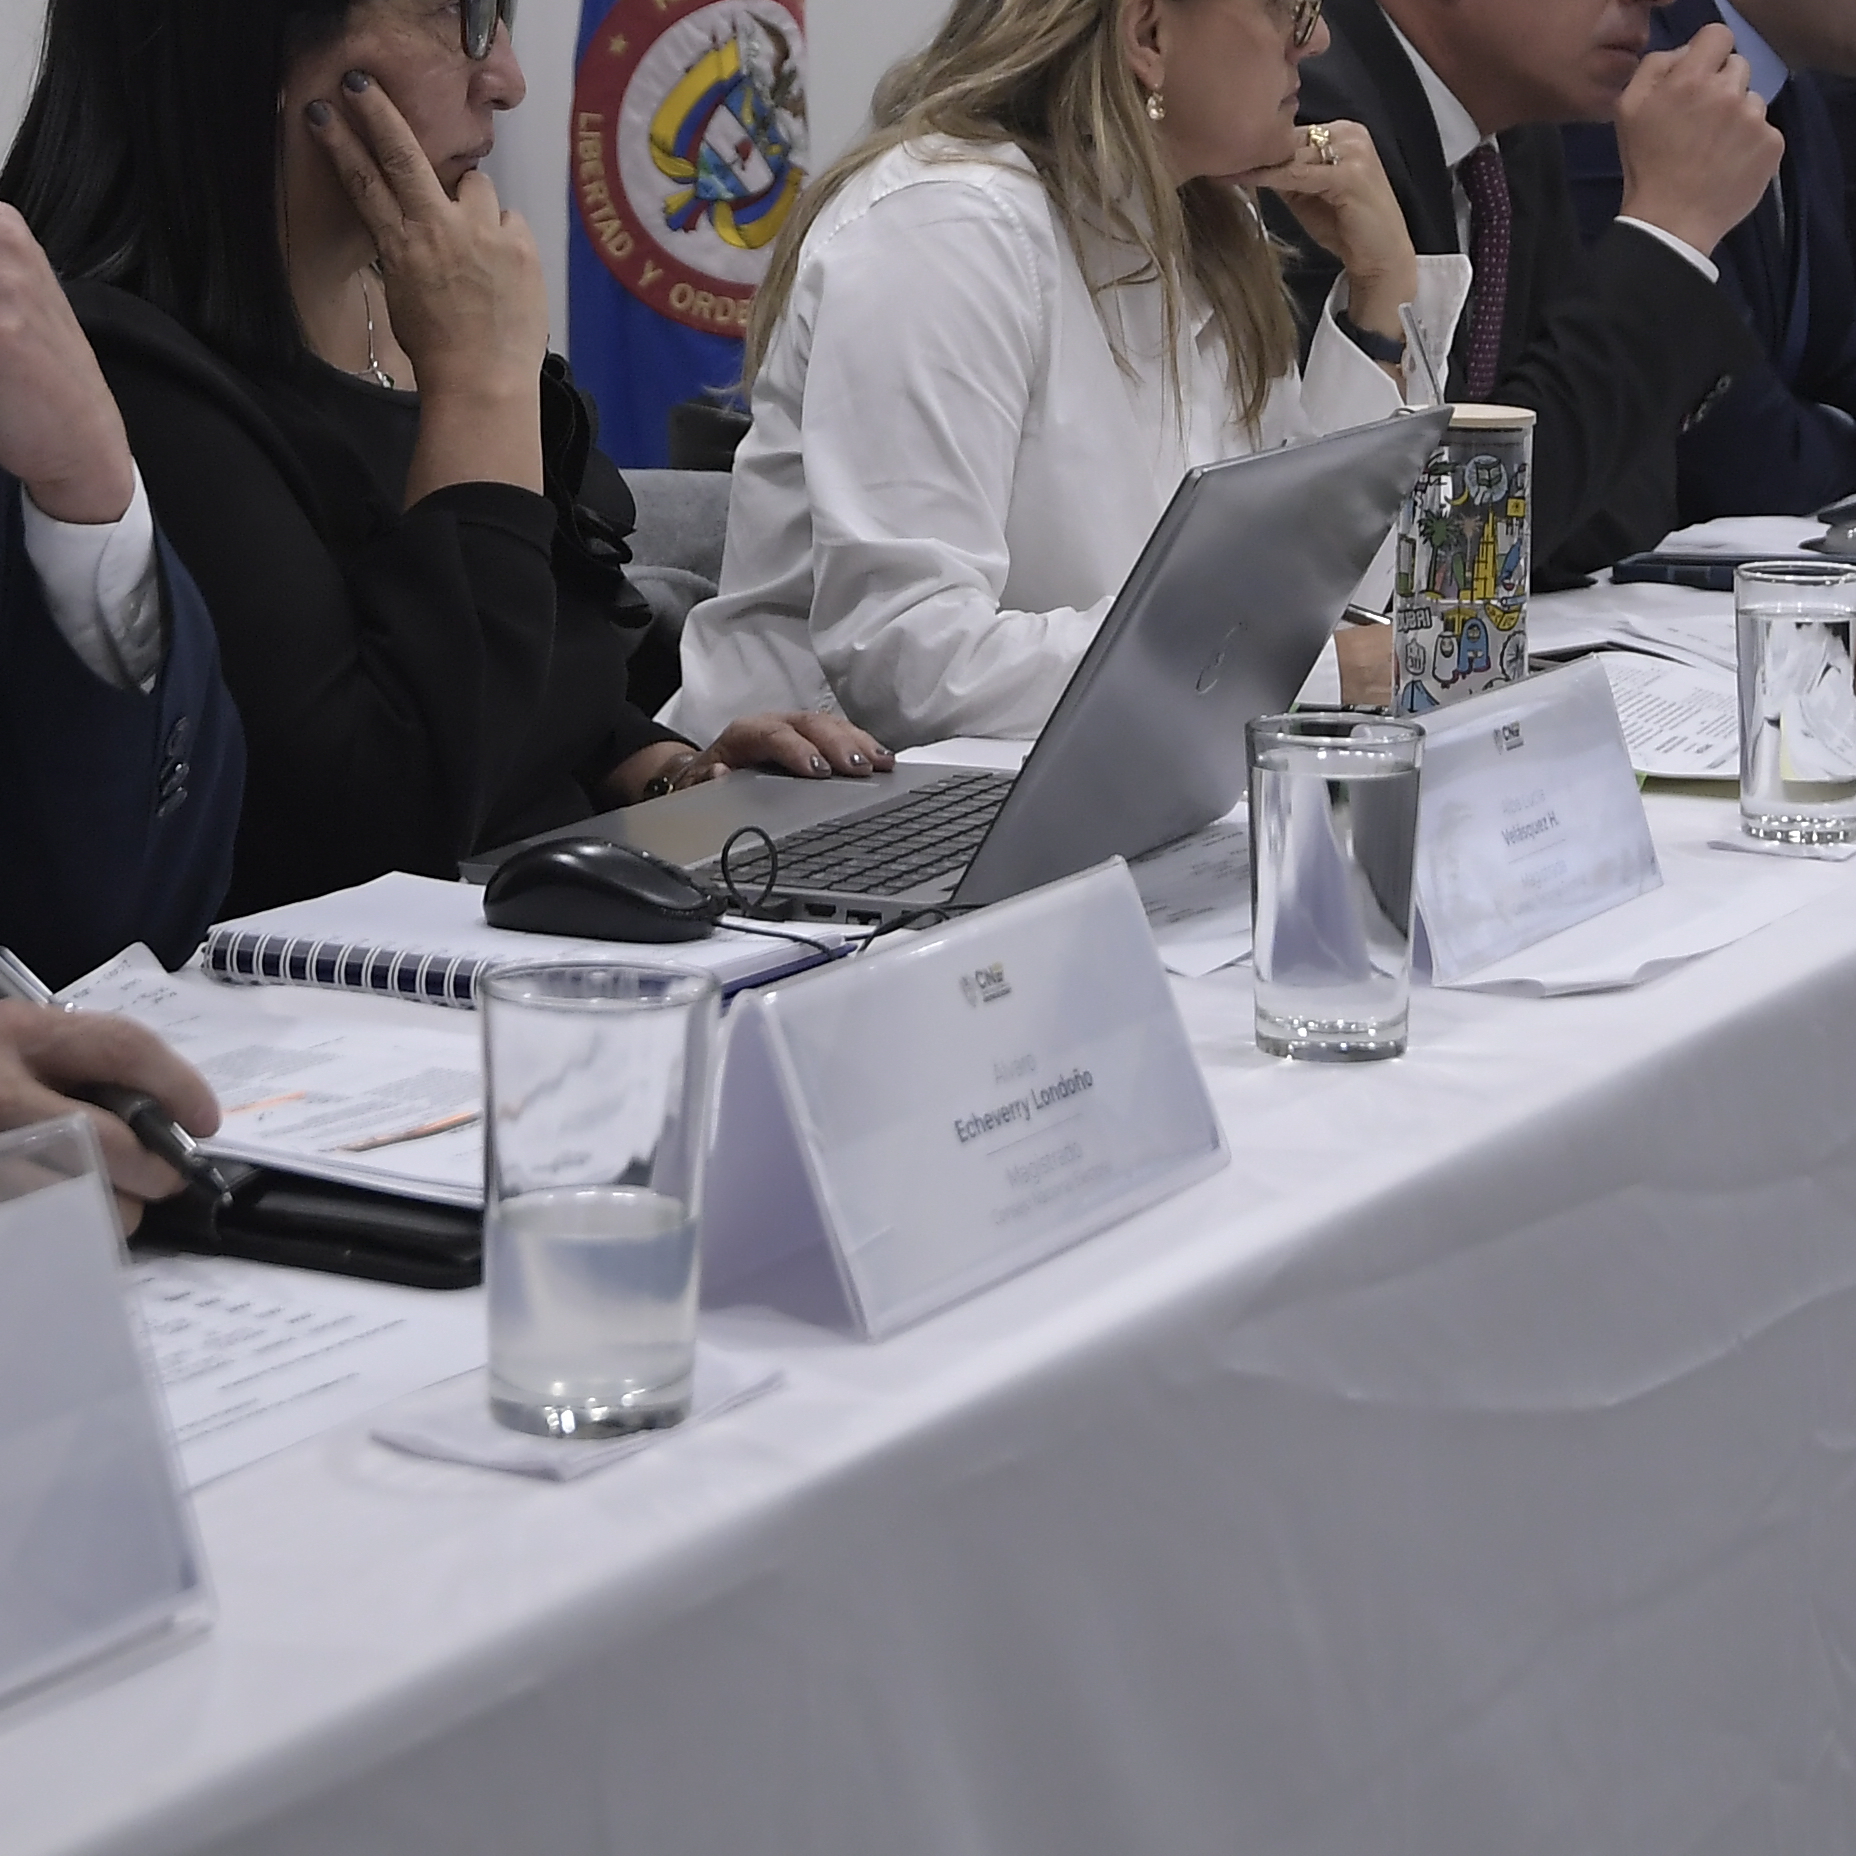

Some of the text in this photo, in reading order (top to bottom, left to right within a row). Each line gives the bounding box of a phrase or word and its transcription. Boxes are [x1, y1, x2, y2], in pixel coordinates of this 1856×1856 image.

[578, 112, 635, 258] LIBERTAD
[637, 259, 664, 288] Y
[954, 1068, 1093, 1143] Echeverry Londoño
